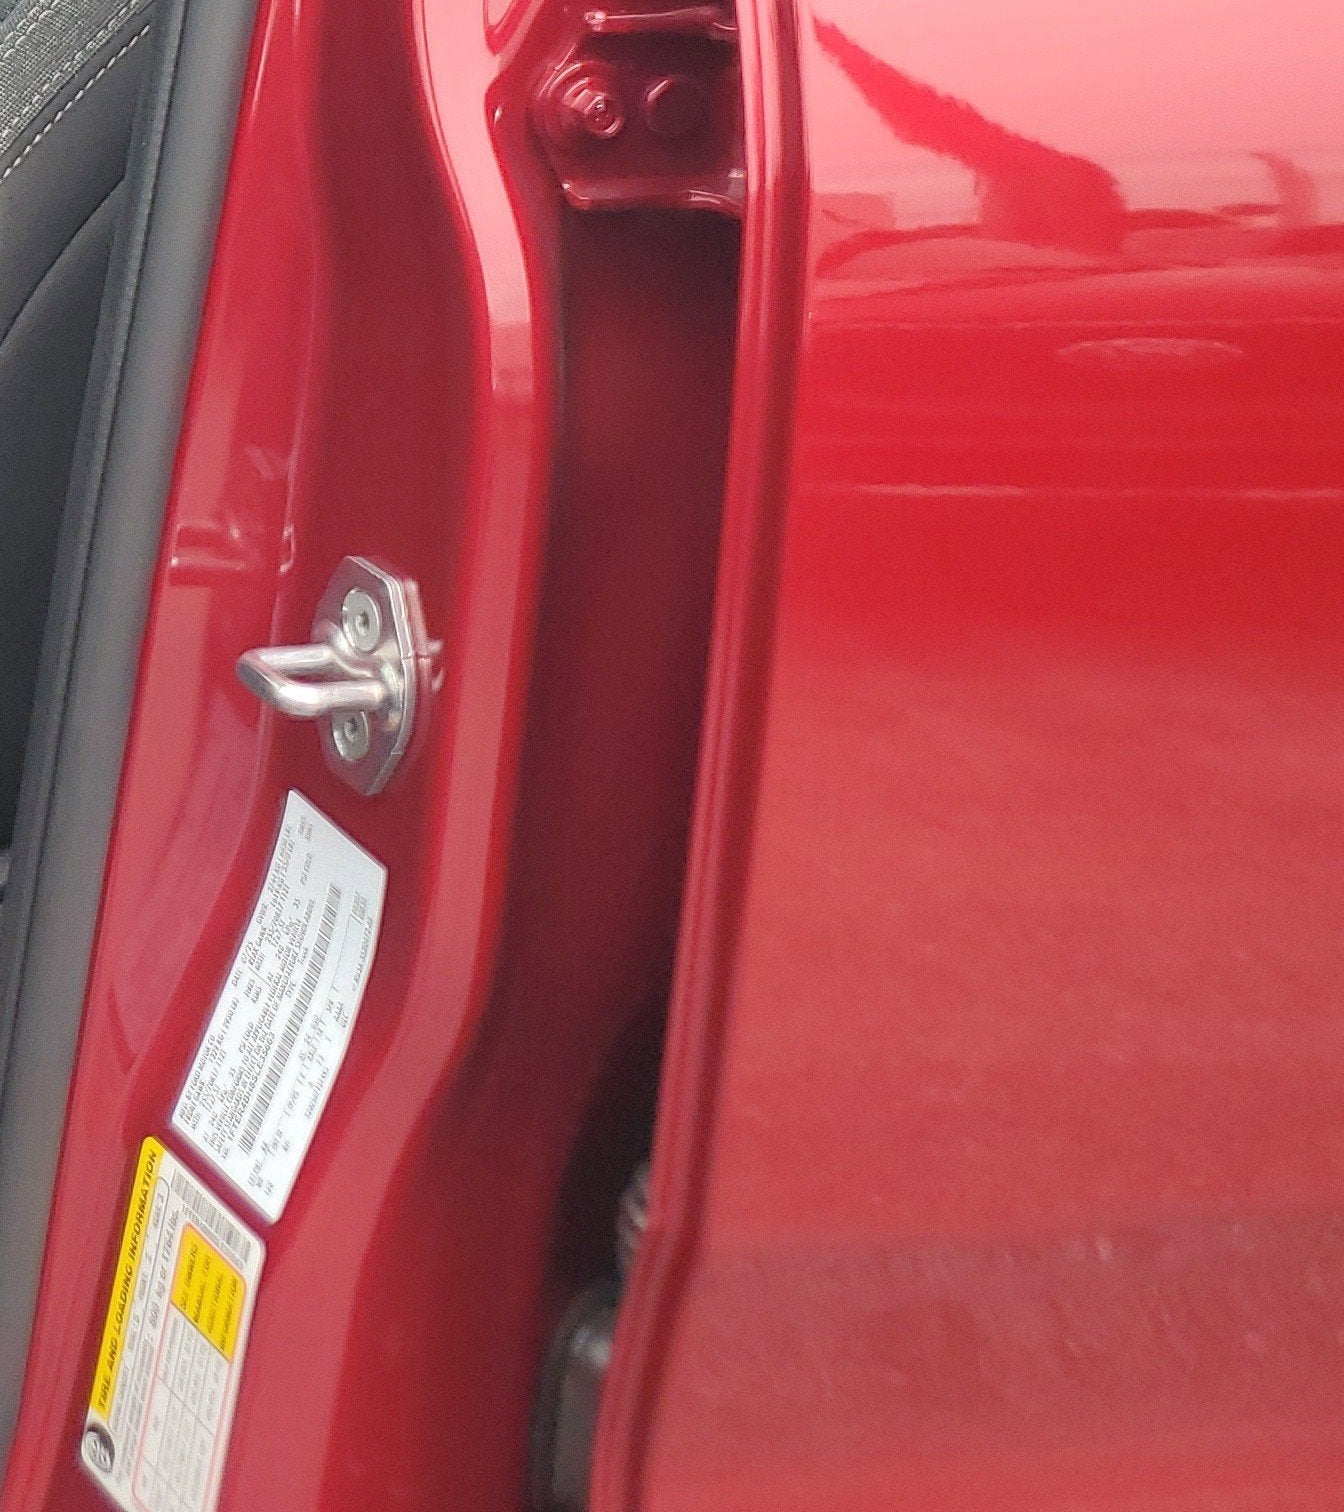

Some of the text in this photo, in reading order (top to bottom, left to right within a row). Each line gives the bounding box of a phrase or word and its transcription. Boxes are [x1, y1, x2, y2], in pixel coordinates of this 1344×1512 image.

[107, 1337, 118, 1372] AND
[114, 1265, 133, 1335] LOADING
[129, 1151, 156, 1260] INFORMATION
